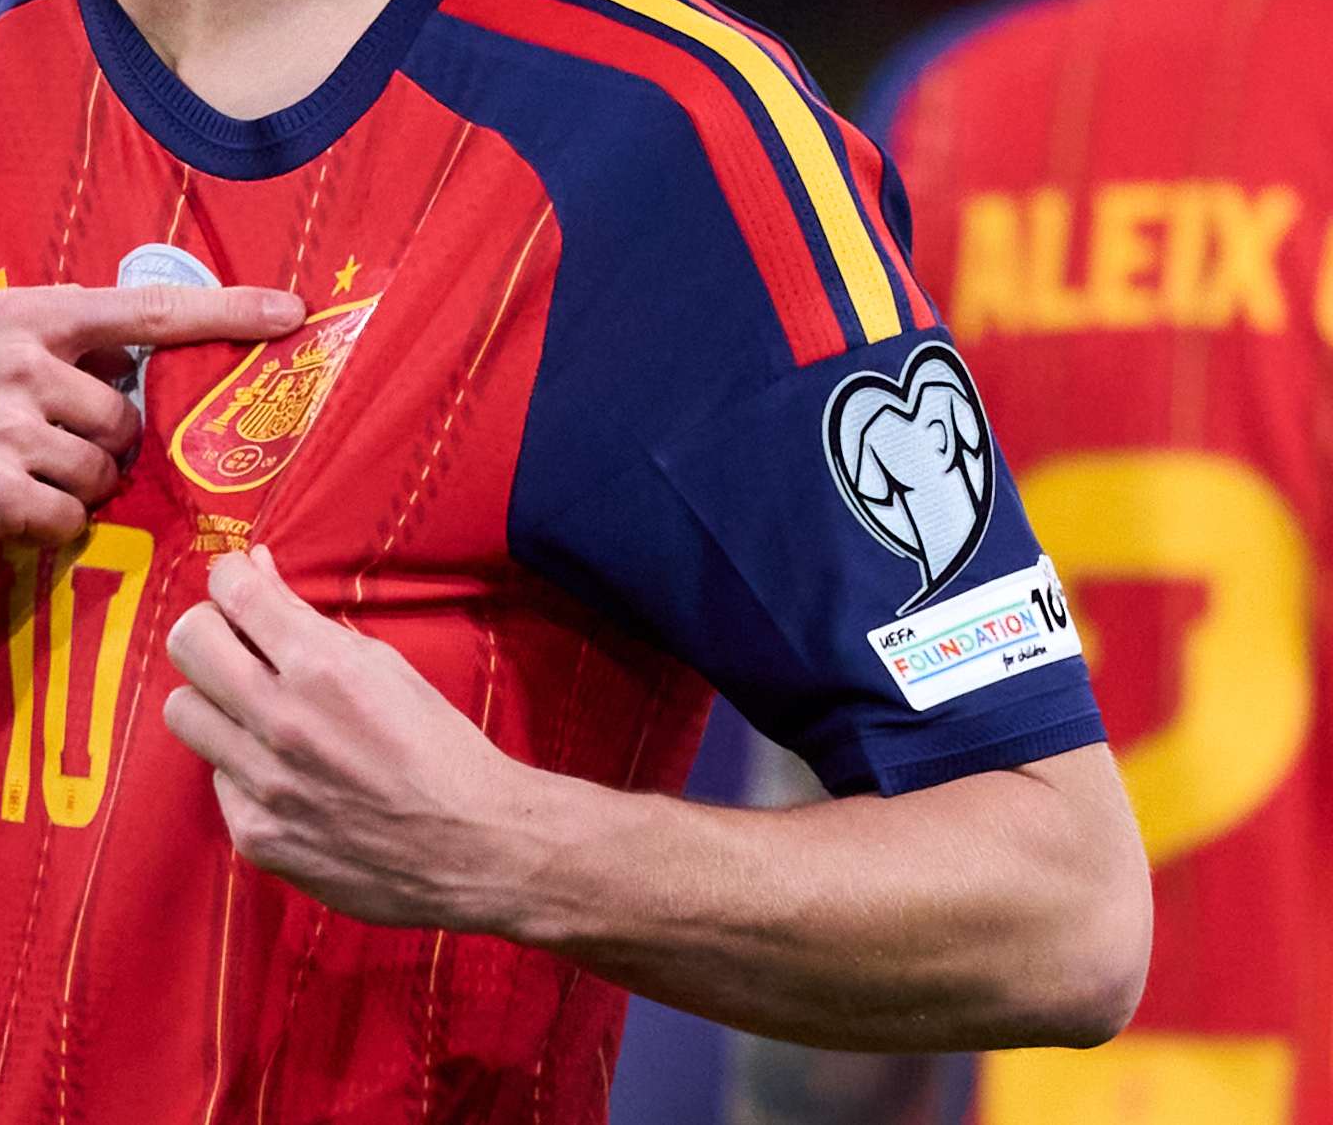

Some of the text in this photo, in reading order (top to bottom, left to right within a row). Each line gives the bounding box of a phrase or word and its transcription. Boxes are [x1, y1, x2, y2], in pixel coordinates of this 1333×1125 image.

[952, 181, 1303, 345] ALEIX
[879, 628, 916, 650] UEFA
[893, 609, 1036, 678] FOUNDATION
[1002, 651, 1014, 672] for
[0, 522, 155, 828] 10
